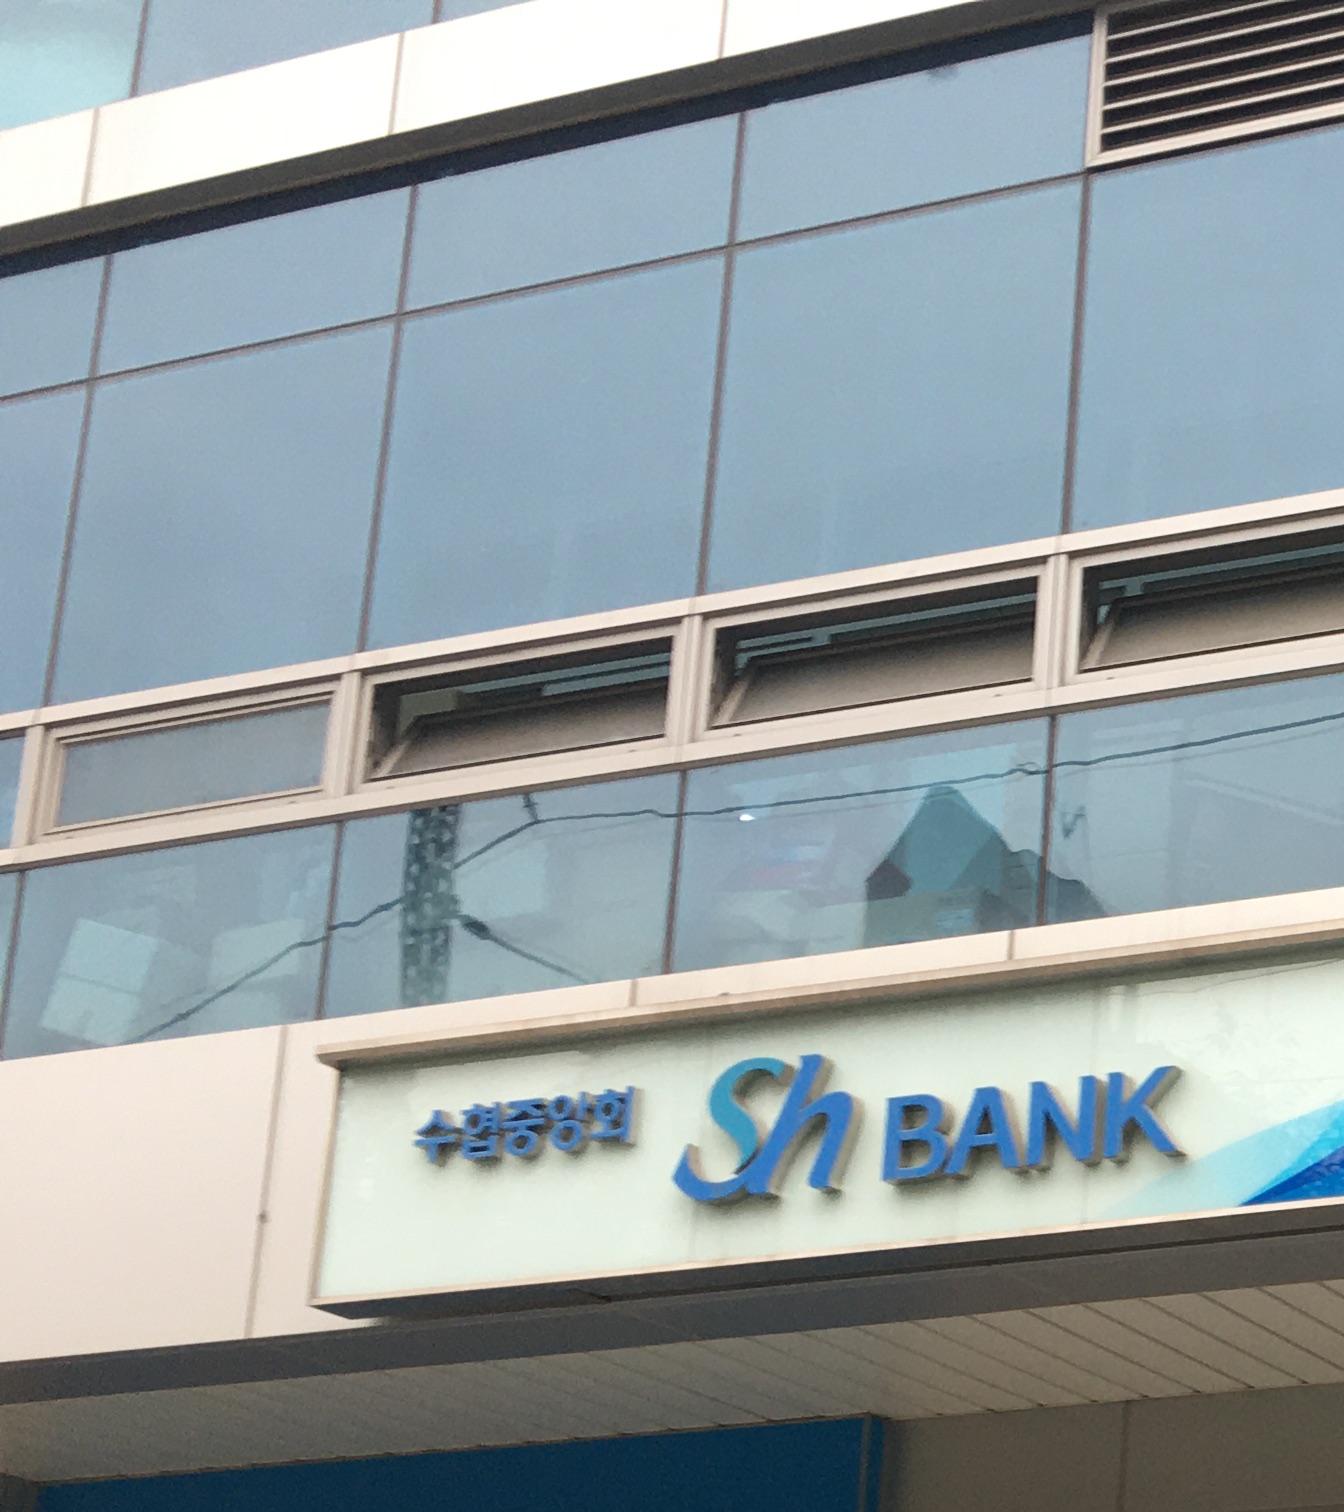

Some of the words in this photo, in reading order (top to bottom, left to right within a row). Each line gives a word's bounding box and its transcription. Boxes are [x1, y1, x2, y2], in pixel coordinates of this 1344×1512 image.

[414, 1083, 641, 1166] 수협중앙회
[672, 1054, 861, 1200] Sh
[882, 1065, 1185, 1186] BANK
